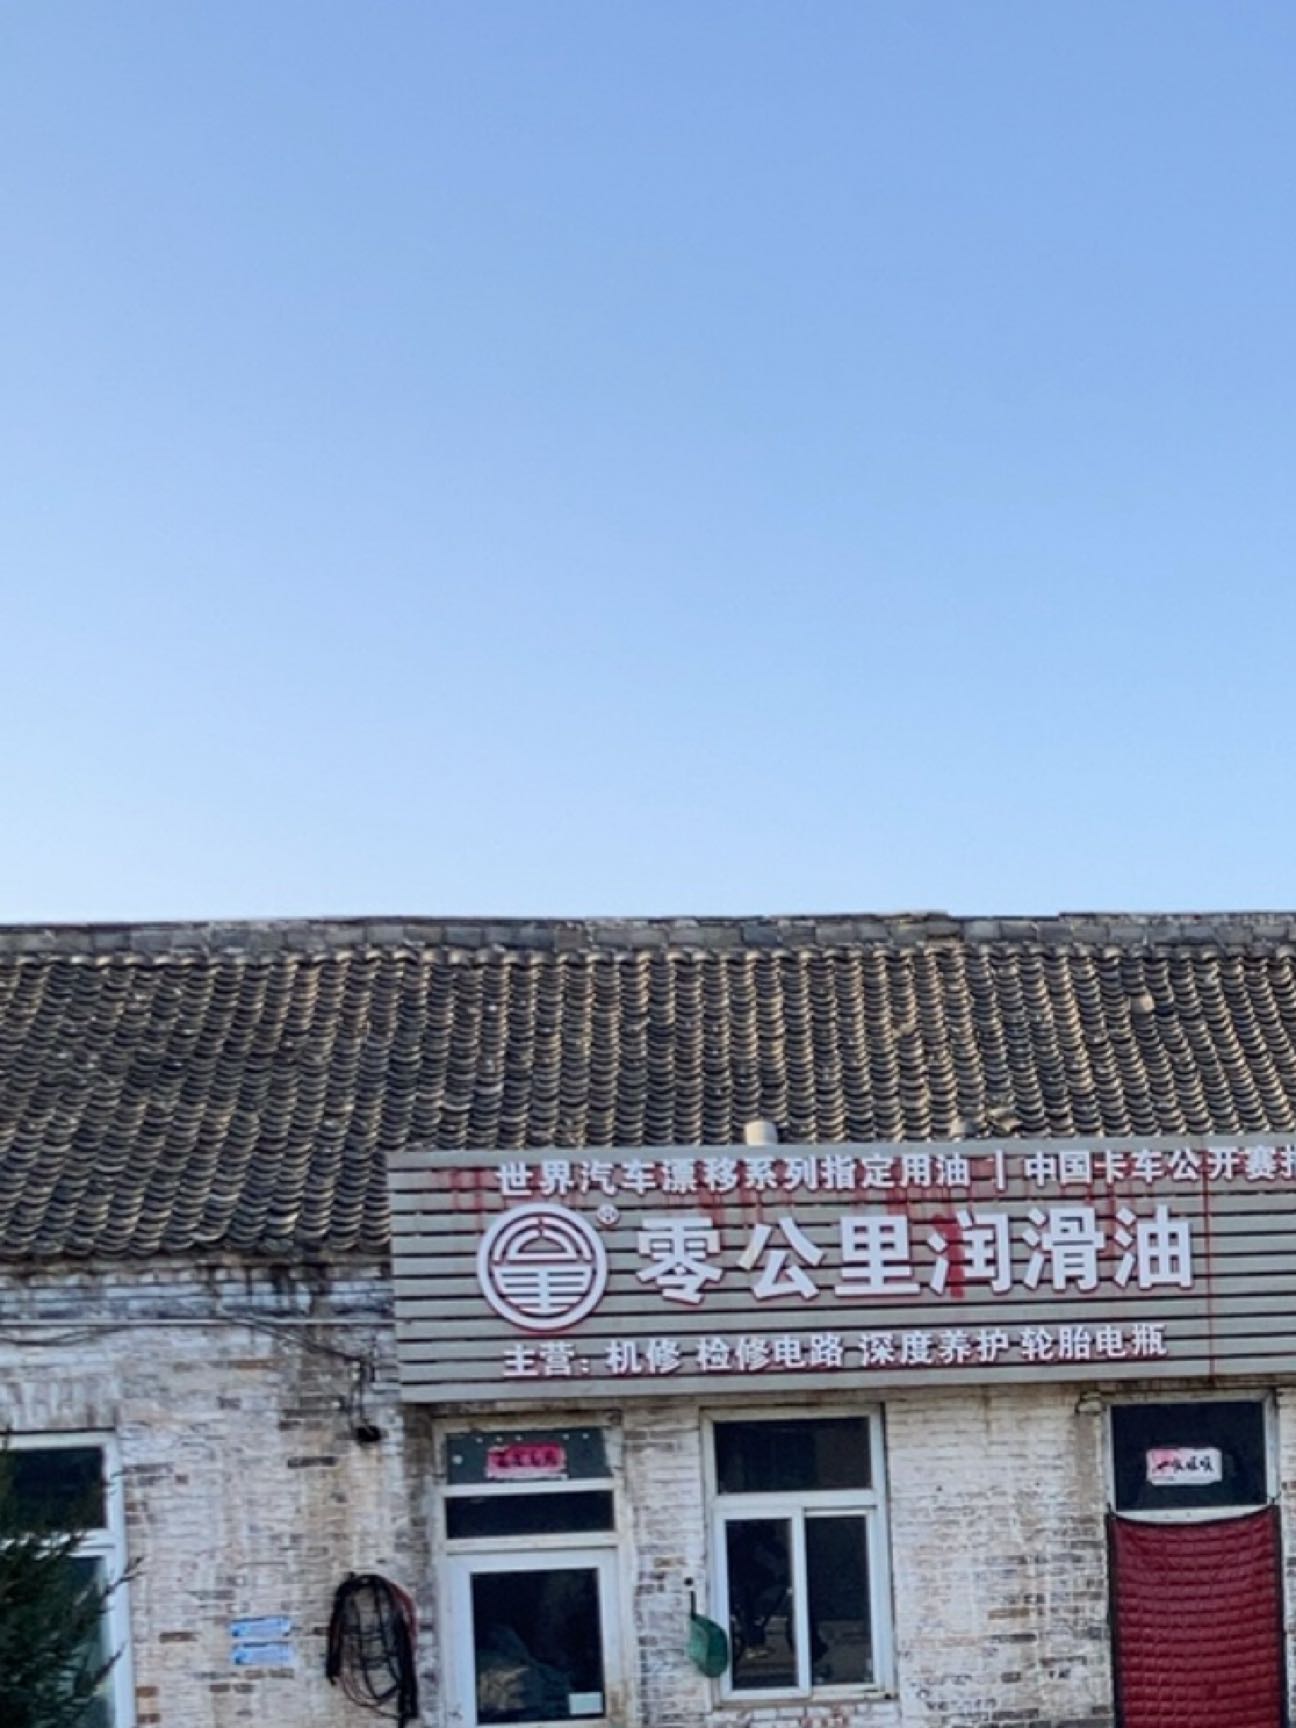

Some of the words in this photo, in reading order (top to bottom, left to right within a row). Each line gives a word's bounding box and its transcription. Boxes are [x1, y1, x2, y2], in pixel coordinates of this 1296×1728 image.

[636, 1203, 1193, 1304] 零公里润滑油
[605, 1337, 685, 1375] 机修
[696, 1331, 845, 1371] 检修电路
[857, 1327, 1010, 1366] 深度养护
[1020, 1323, 1168, 1362] 轮胎电瓶
